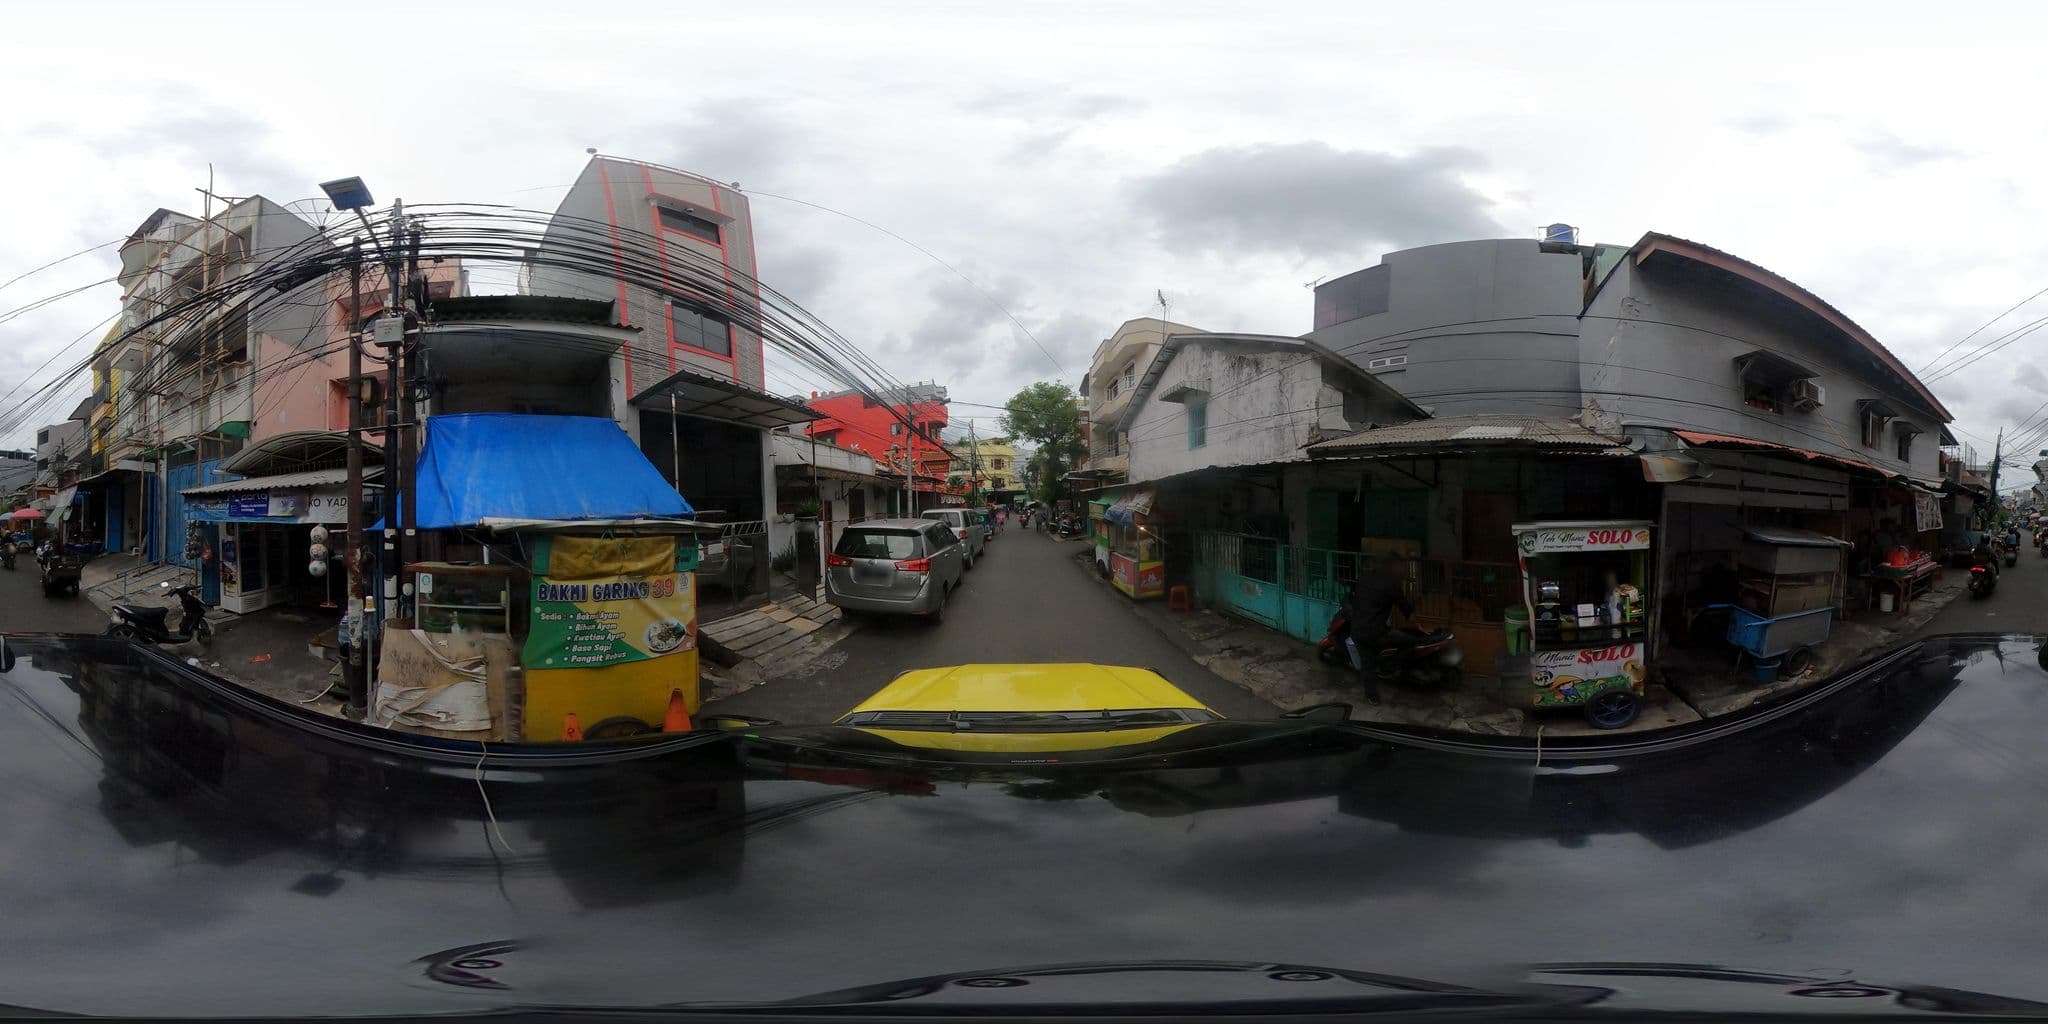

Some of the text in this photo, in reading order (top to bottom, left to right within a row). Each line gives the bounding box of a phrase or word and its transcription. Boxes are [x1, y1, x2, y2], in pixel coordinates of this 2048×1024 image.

[1540, 532, 1556, 544] Teh
[1587, 530, 1632, 544] SOLO
[538, 579, 674, 602] BAKMI GARING 39
[599, 611, 620, 621] Ayam
[597, 622, 618, 631] Ayam
[571, 654, 604, 663] Pangsit
[1538, 644, 1634, 663] Manis SOLO
